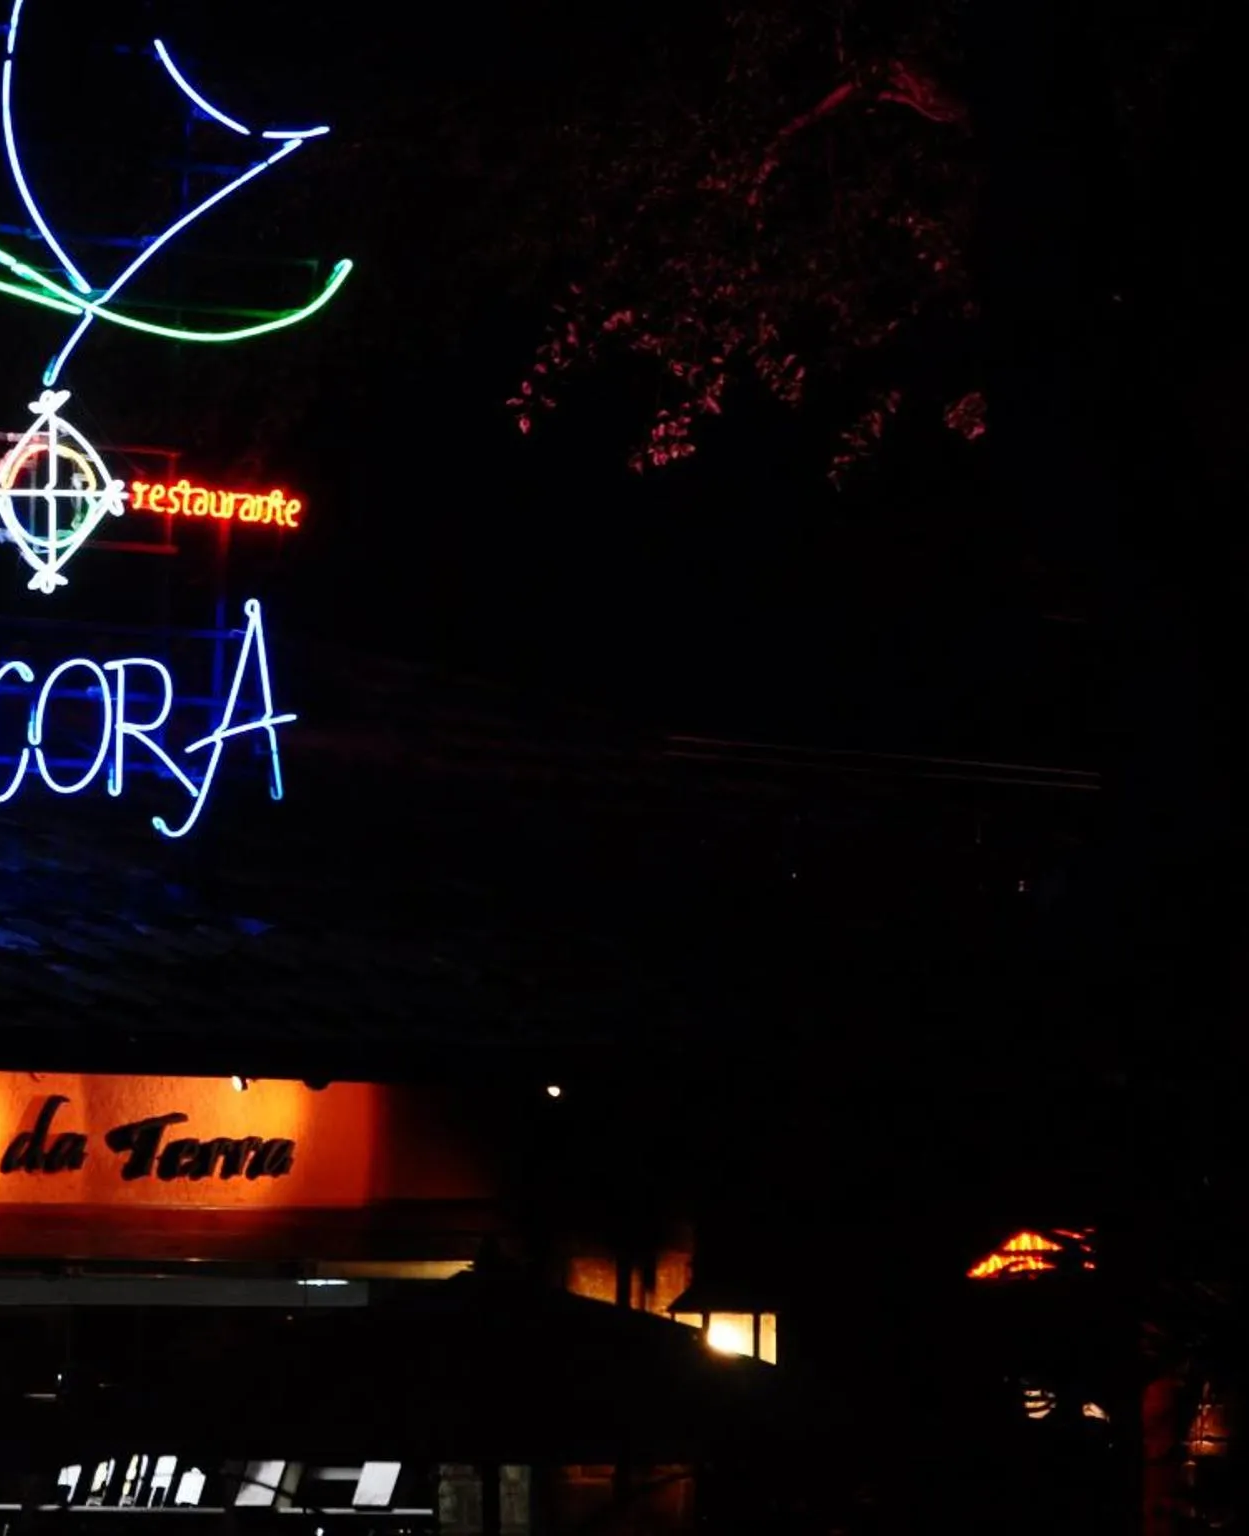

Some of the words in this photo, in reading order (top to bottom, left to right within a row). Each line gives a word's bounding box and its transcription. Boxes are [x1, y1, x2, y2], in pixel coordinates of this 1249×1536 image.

[132, 480, 301, 527] restaurante
[0, 1095, 88, 1174] da
[105, 1112, 295, 1180] Terra
